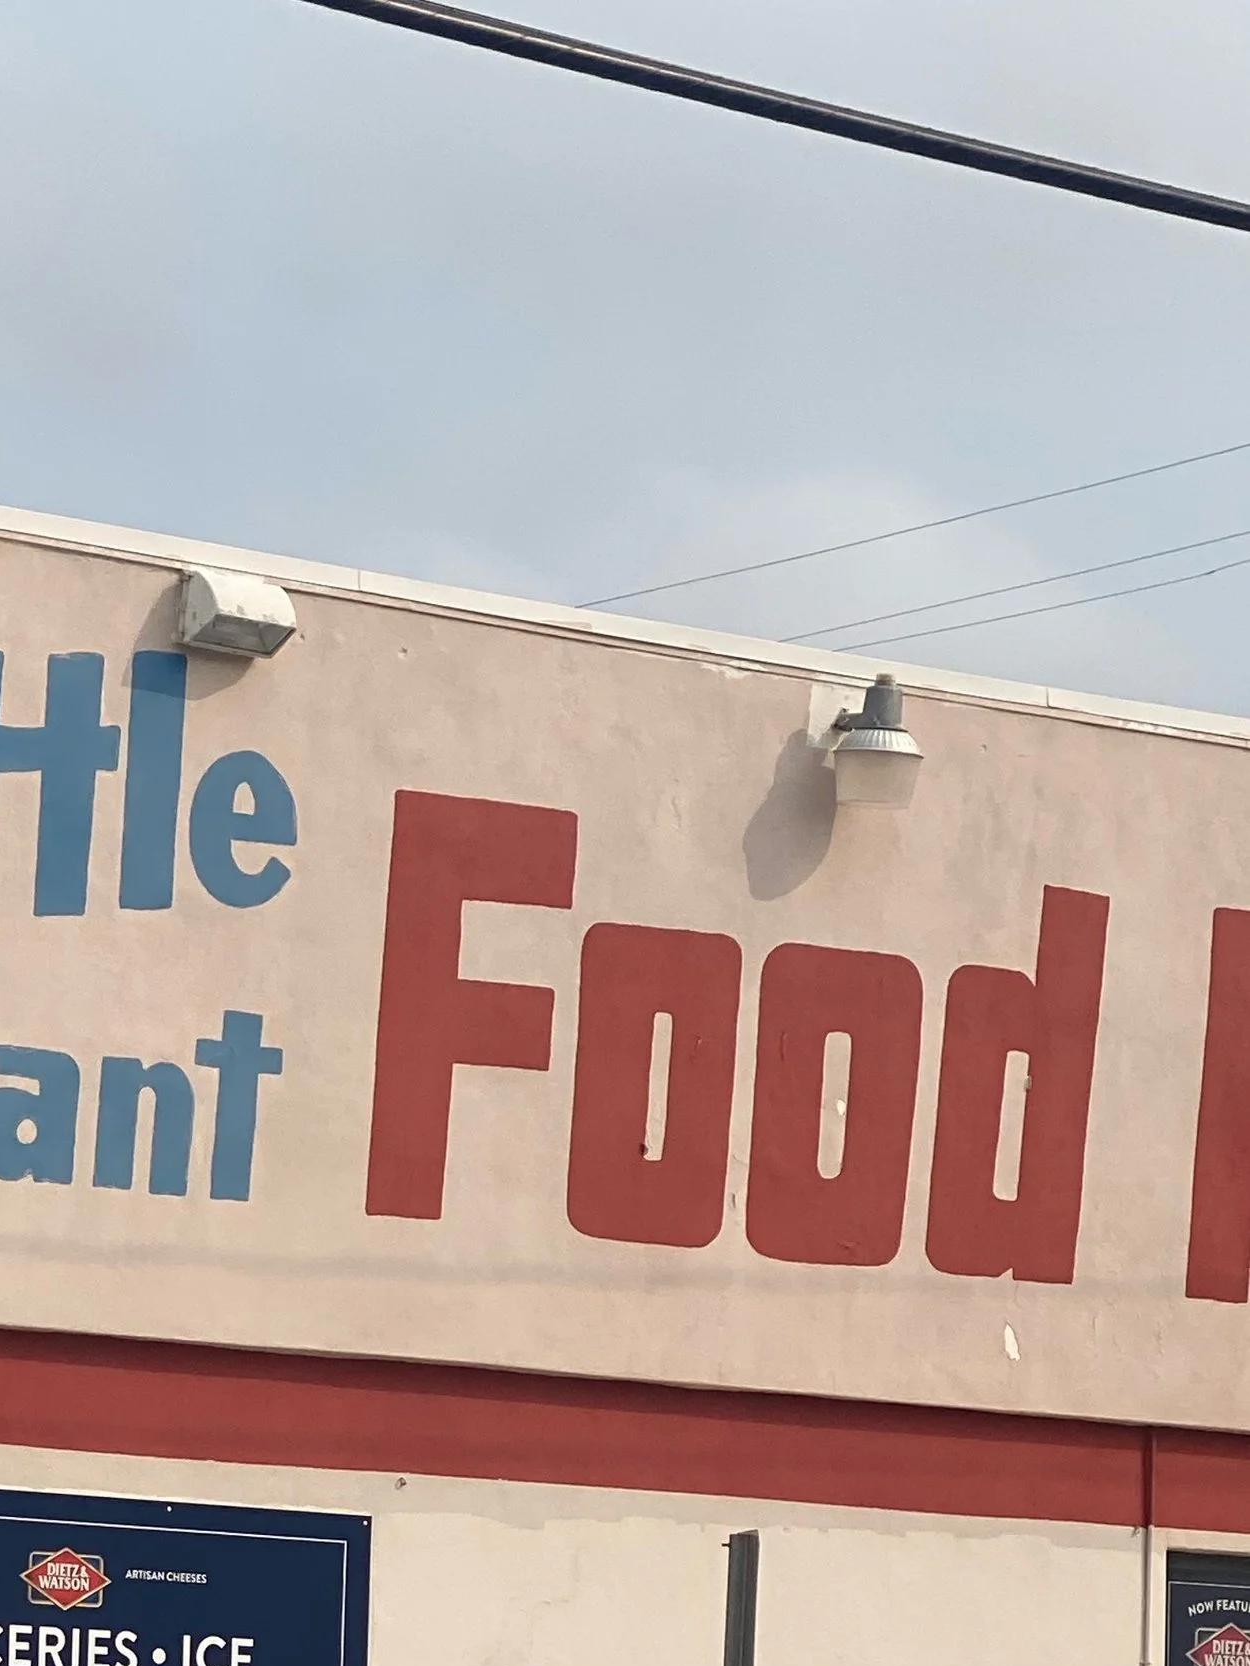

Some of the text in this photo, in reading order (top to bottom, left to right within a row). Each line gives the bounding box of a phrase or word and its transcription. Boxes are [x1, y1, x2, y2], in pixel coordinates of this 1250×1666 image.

[365, 790, 1110, 1284] Food
[38, 1575, 90, 1592] WATSON
[125, 1569, 208, 1584] ARTISAN CHEESES
[1188, 1598, 1250, 1617] NOW FEATU
